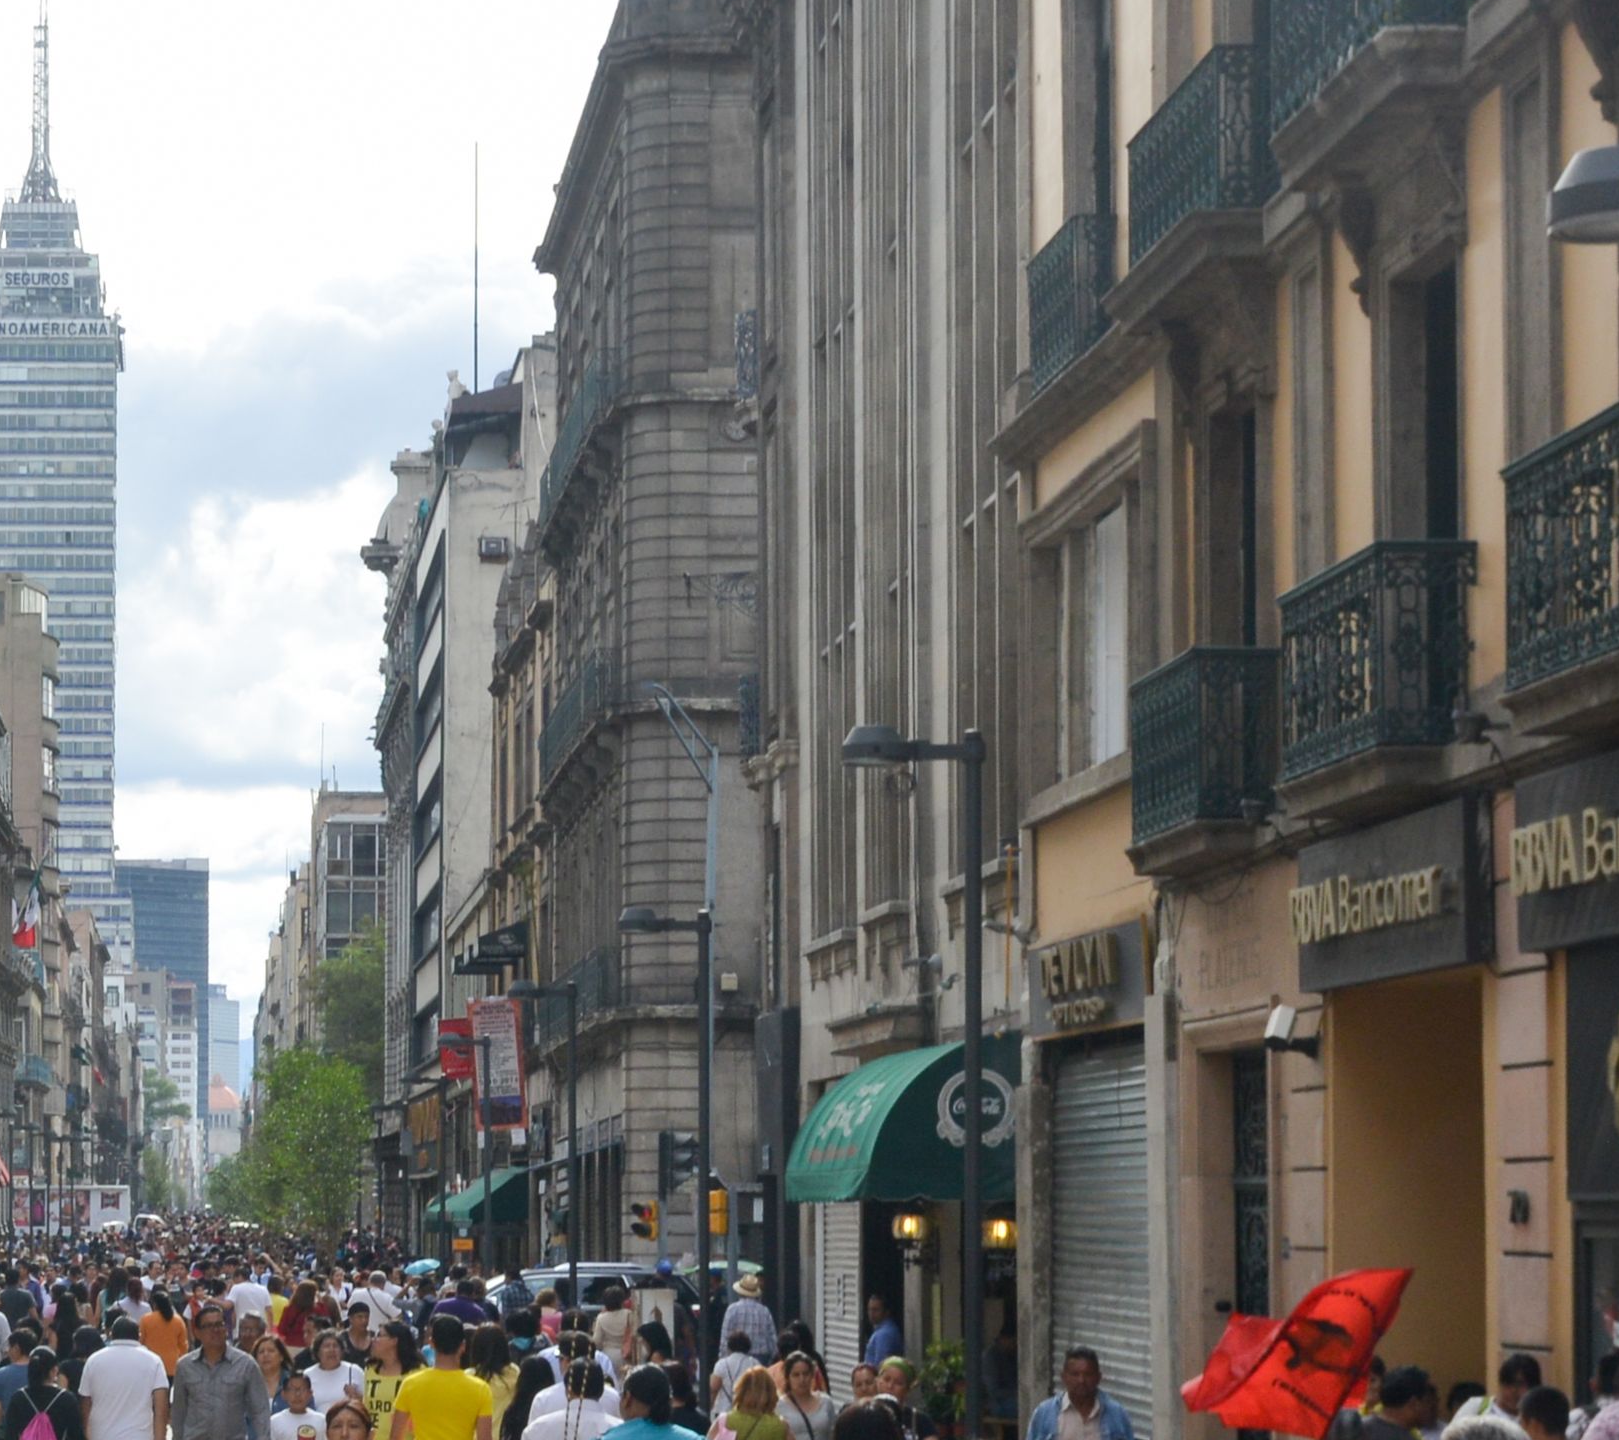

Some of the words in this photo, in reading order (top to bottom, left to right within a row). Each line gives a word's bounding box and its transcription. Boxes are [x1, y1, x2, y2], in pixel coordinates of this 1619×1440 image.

[4, 271, 70, 287] SEGUROS
[1508, 812, 1582, 899] BBVA
[1289, 877, 1336, 945] BBVA
[1338, 864, 1442, 935] Bancomer
[1039, 929, 1119, 999] DEVLYN
